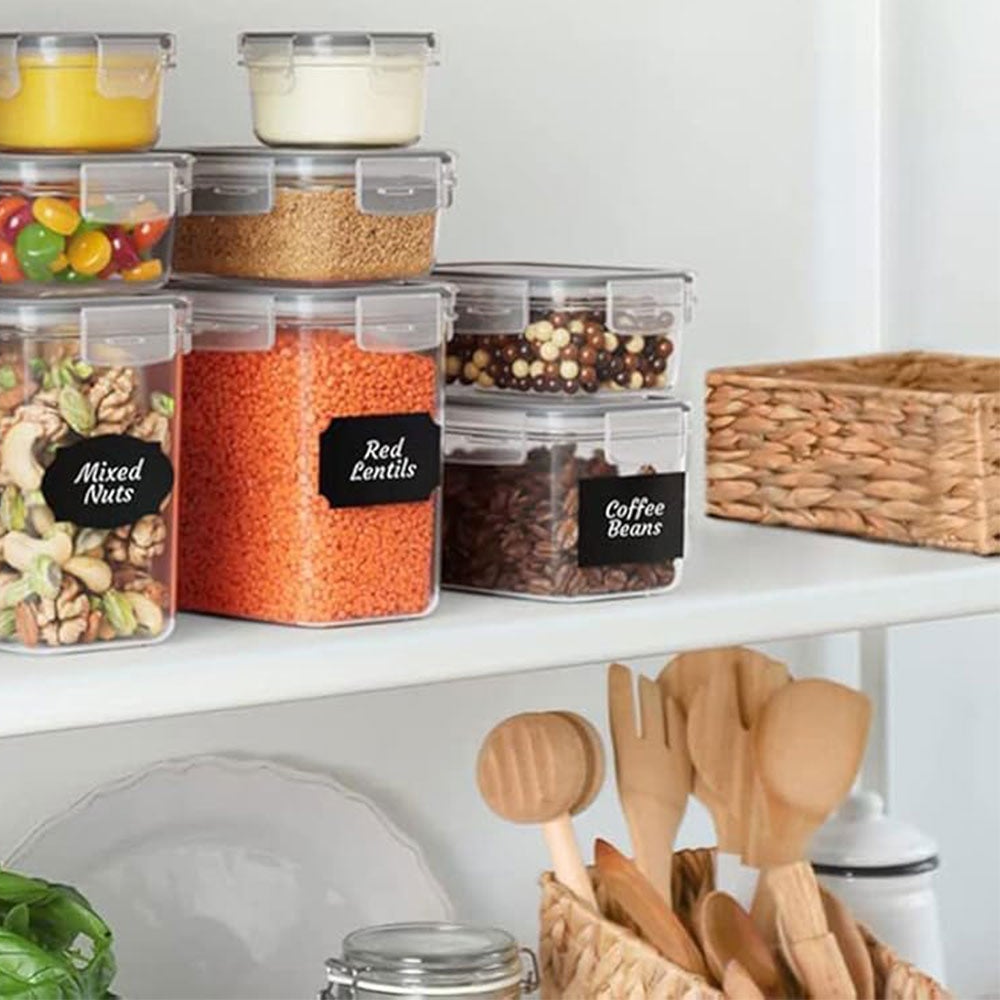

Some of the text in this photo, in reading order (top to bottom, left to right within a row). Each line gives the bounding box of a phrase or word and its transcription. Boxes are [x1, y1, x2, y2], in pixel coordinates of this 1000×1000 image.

[363, 436, 405, 460] Red
[73, 457, 145, 484] Mixed
[349, 457, 418, 482] Lentils
[83, 483, 135, 505] Nuts
[605, 496, 666, 520] Coffee
[607, 519, 663, 538] Beans
